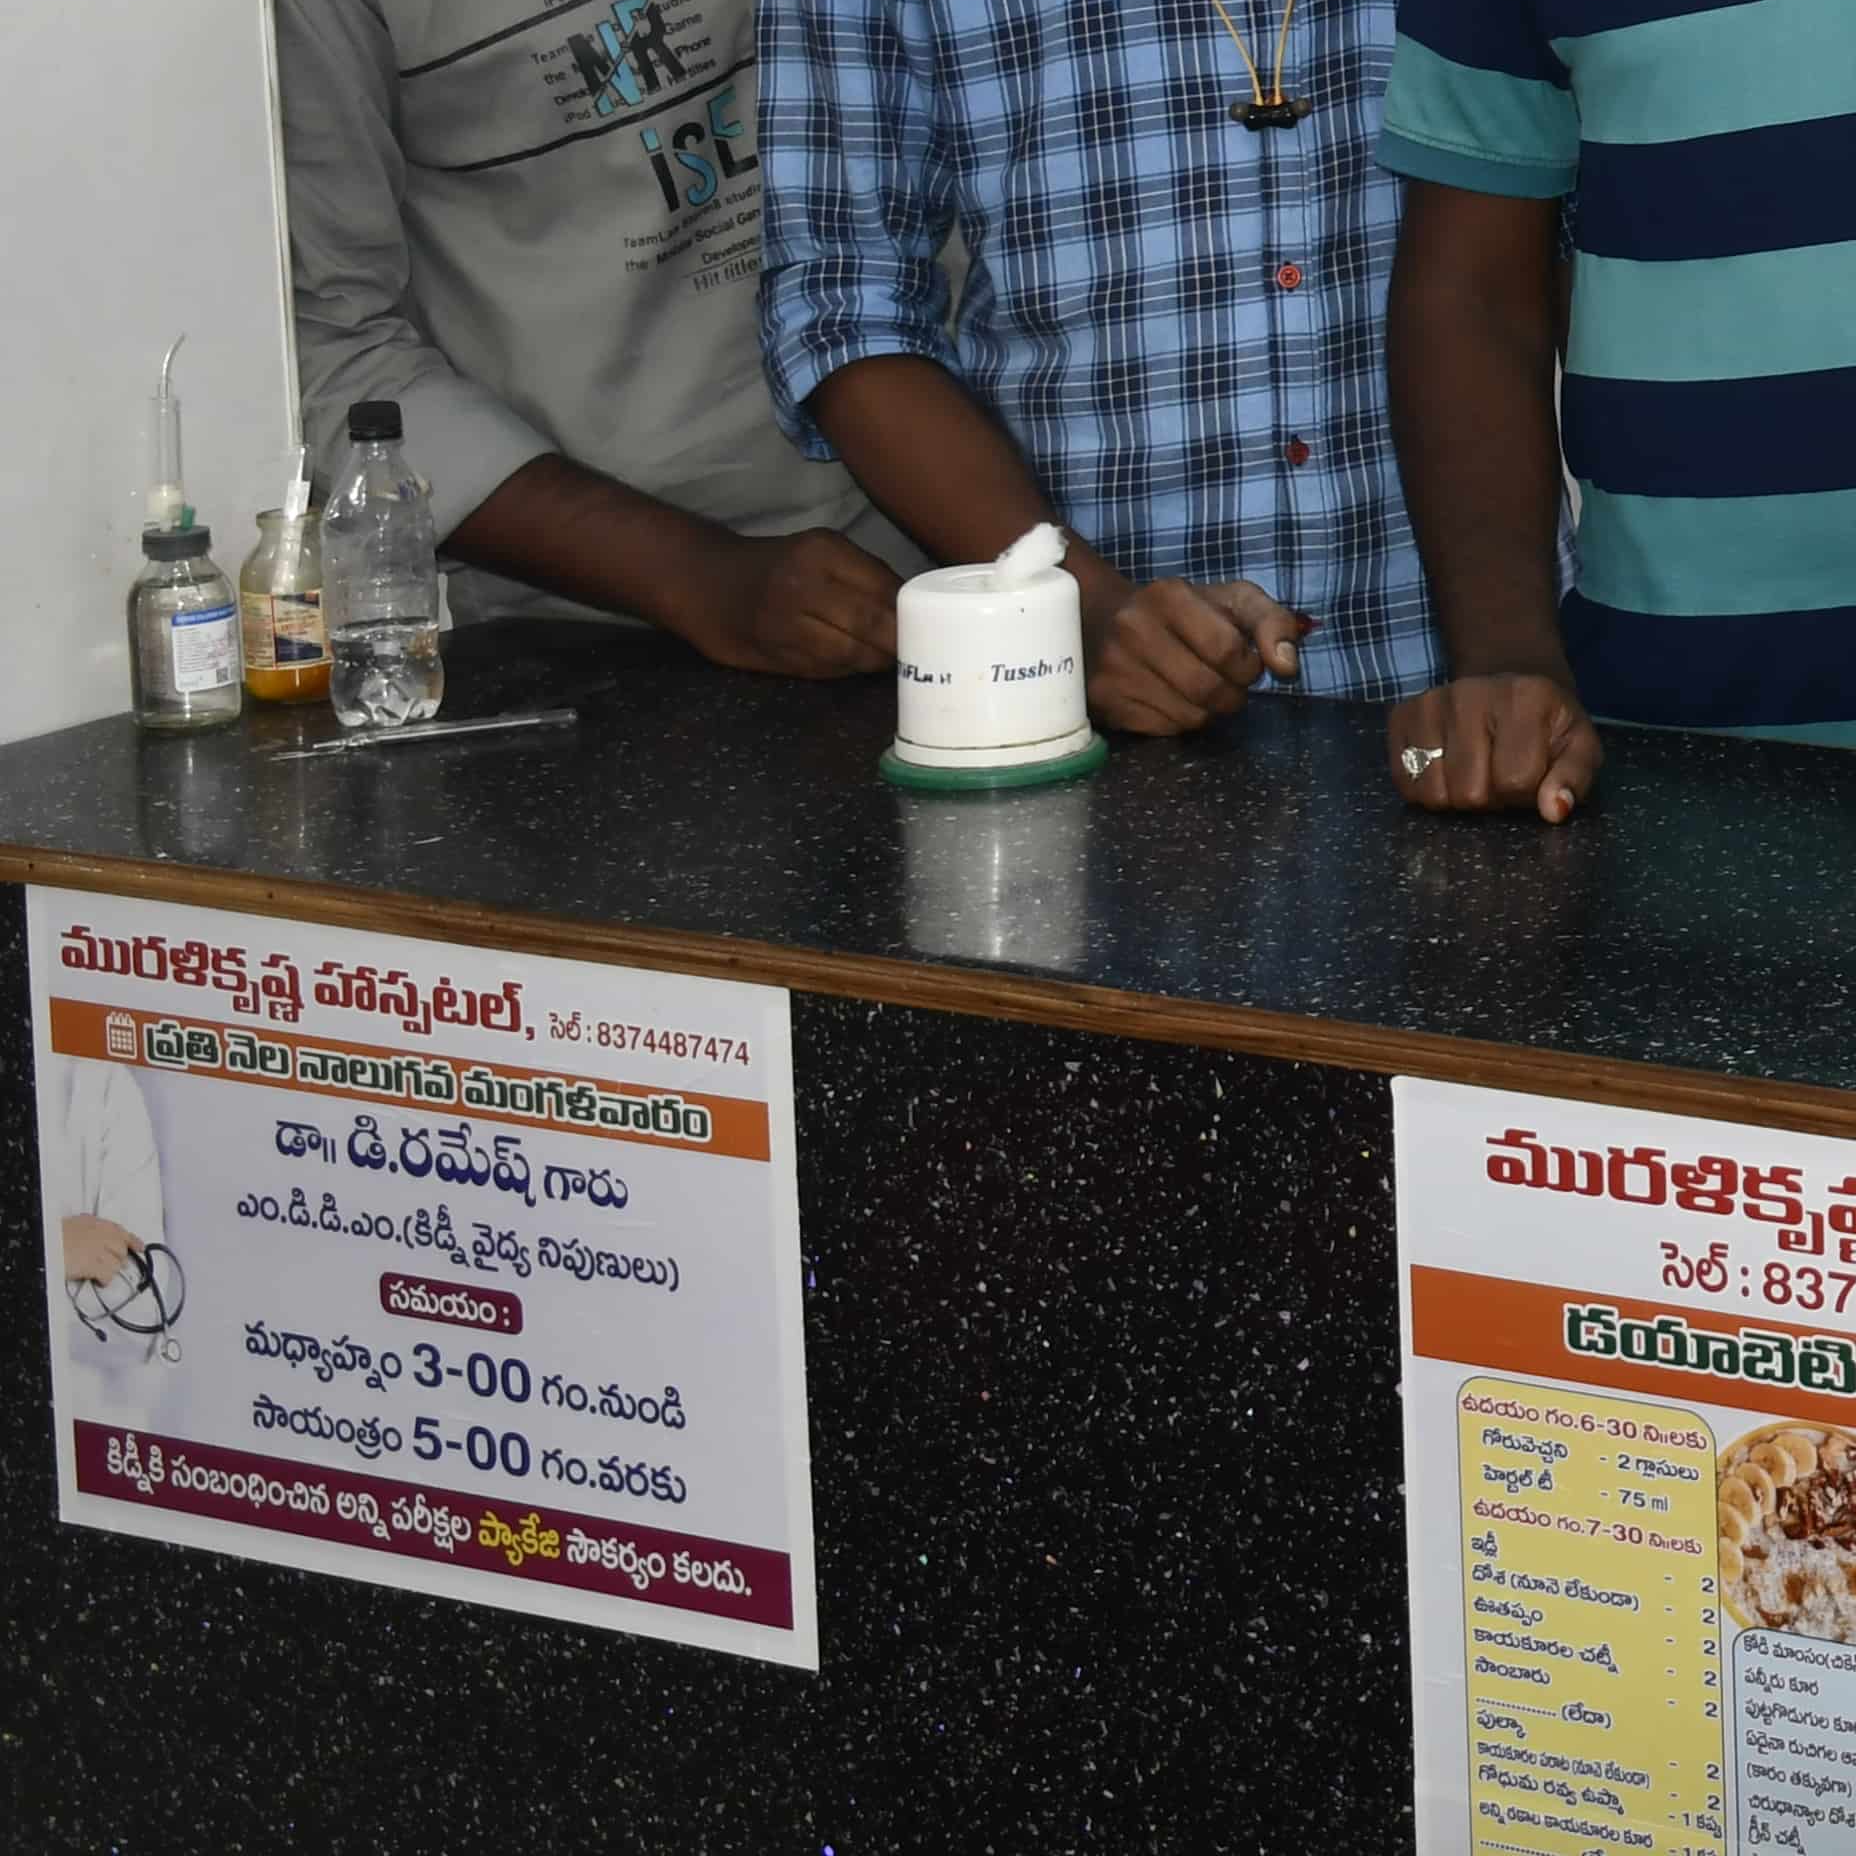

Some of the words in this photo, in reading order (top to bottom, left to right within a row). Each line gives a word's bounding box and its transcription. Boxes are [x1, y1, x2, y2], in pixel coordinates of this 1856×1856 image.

[142, 1019, 220, 1067] ప్రతి
[226, 1031, 290, 1077] నెల
[297, 1045, 456, 1104] నాలుగవ
[463, 1069, 712, 1142] మంగళవారం
[545, 1163, 630, 1212] గారు
[473, 1220, 532, 1279] వైద్య
[1659, 1239, 1729, 1297] సెల్
[412, 1342, 530, 1403] 3-00
[253, 1392, 402, 1461] సాయంత్రం
[412, 1417, 530, 1478] 5-00
[1463, 1393, 1539, 1423] ఉదయం
[172, 1455, 329, 1518] సంబంధించిన
[336, 1493, 390, 1543] అన్ని
[394, 1496, 473, 1558] పరీక్షల
[566, 1528, 666, 1593] సౌకర్యం
[1618, 1489, 1645, 1510] 75
[1475, 1656, 1550, 1686] సాంబారు
